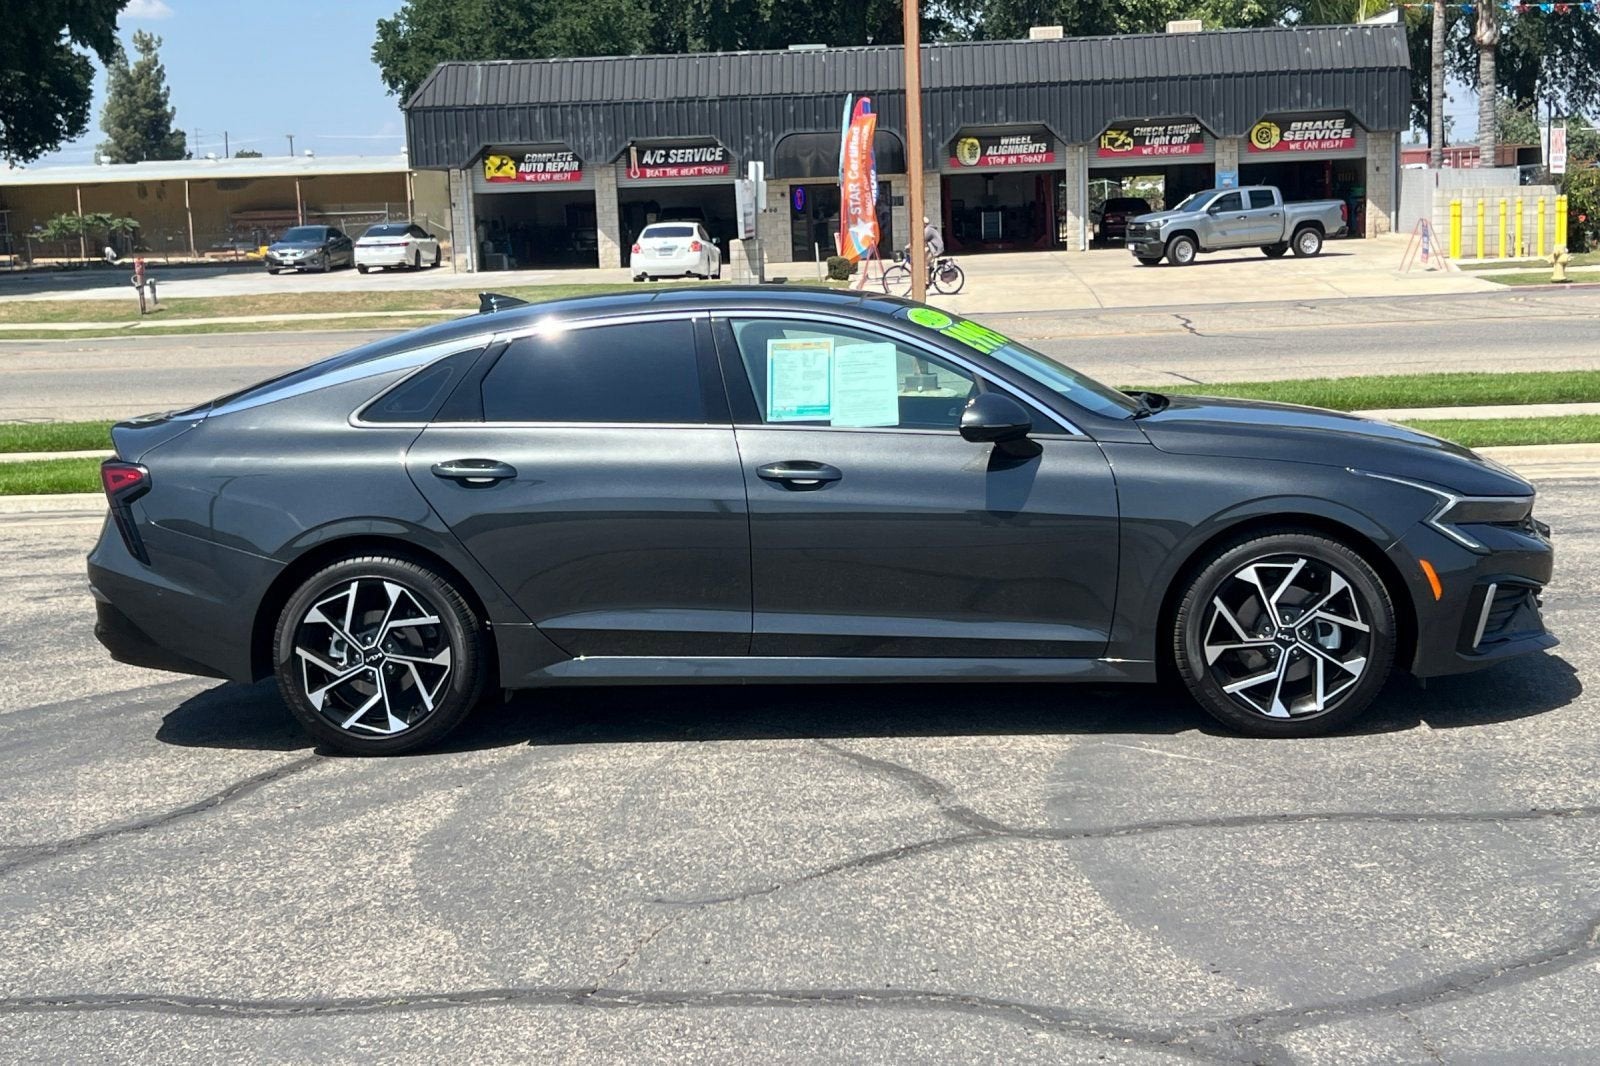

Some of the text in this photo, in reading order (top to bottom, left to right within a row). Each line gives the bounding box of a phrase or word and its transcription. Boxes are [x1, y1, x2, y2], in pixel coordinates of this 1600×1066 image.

[1133, 123, 1201, 136] CHECK ENGINE
[1290, 119, 1345, 131] BRAKE
[1000, 136, 1032, 145] WHEEL
[1145, 134, 1190, 146] Light on?
[1282, 128, 1352, 141] SERVICE
[986, 143, 1047, 156] ALIGNMENTS
[1142, 147, 1152, 155] WE
[1154, 146, 1168, 154] CAN
[1289, 142, 1301, 150] WE
[1304, 141, 1318, 150] CAN
[524, 152, 574, 163] COMPLETE
[642, 147, 723, 165] A/C SERVICE
[987, 156, 1005, 165] STOP
[1008, 155, 1017, 163] IN
[519, 161, 579, 173] AUTO REPAIR
[646, 168, 664, 178] BEAT
[666, 167, 679, 177] THE
[681, 167, 699, 176] HEAT
[848, 126, 862, 215] STAR Certified
[537, 173, 551, 181] CAN
